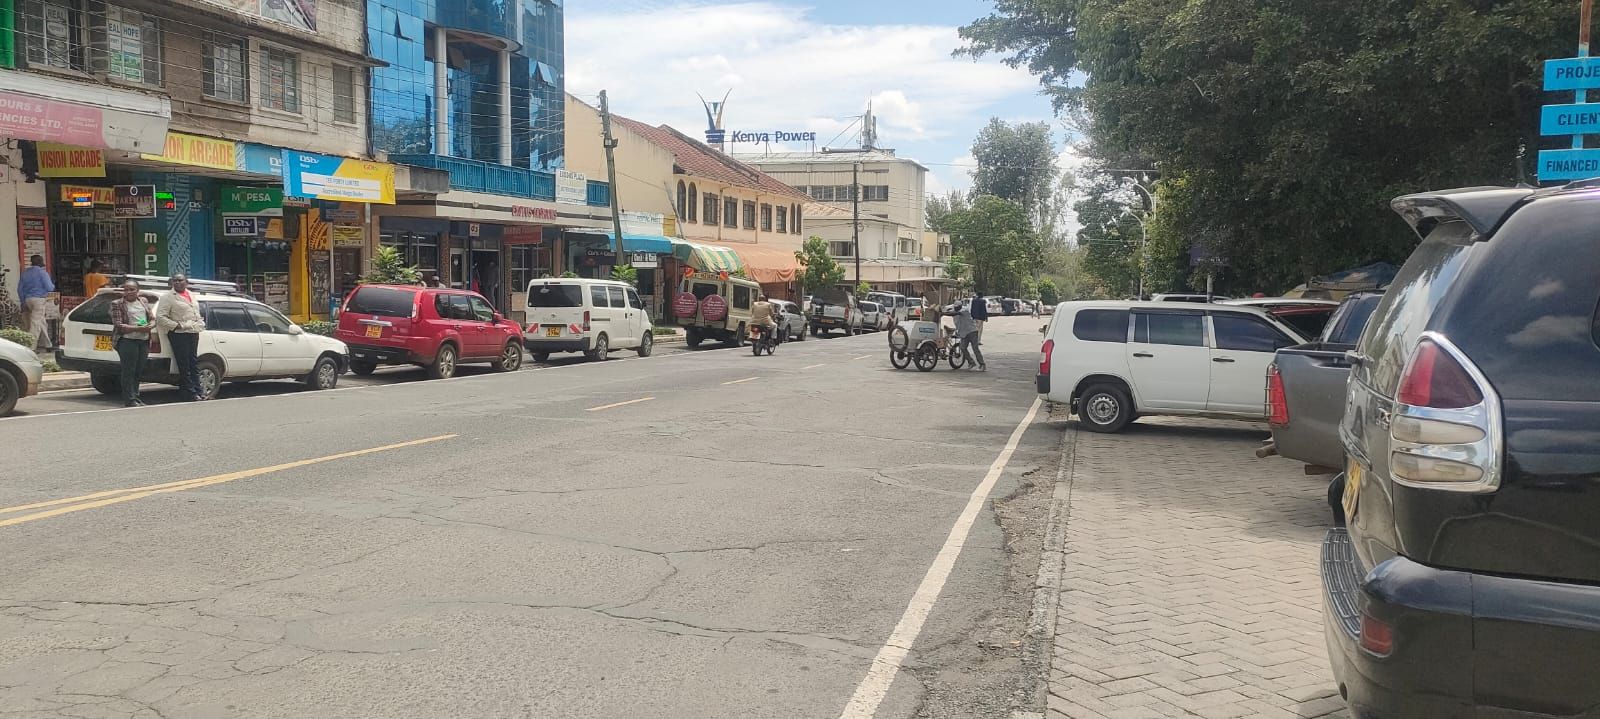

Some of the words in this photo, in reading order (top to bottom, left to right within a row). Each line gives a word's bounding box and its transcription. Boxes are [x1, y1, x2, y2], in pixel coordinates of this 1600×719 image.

[123, 27, 140, 37] HOPE
[732, 130, 769, 146] Kenya
[775, 131, 816, 143] Power
[40, 150, 67, 168] VISION
[70, 149, 102, 168] ARCADE
[190, 141, 233, 167] ARCADE
[1546, 160, 1598, 173] FINANCED
